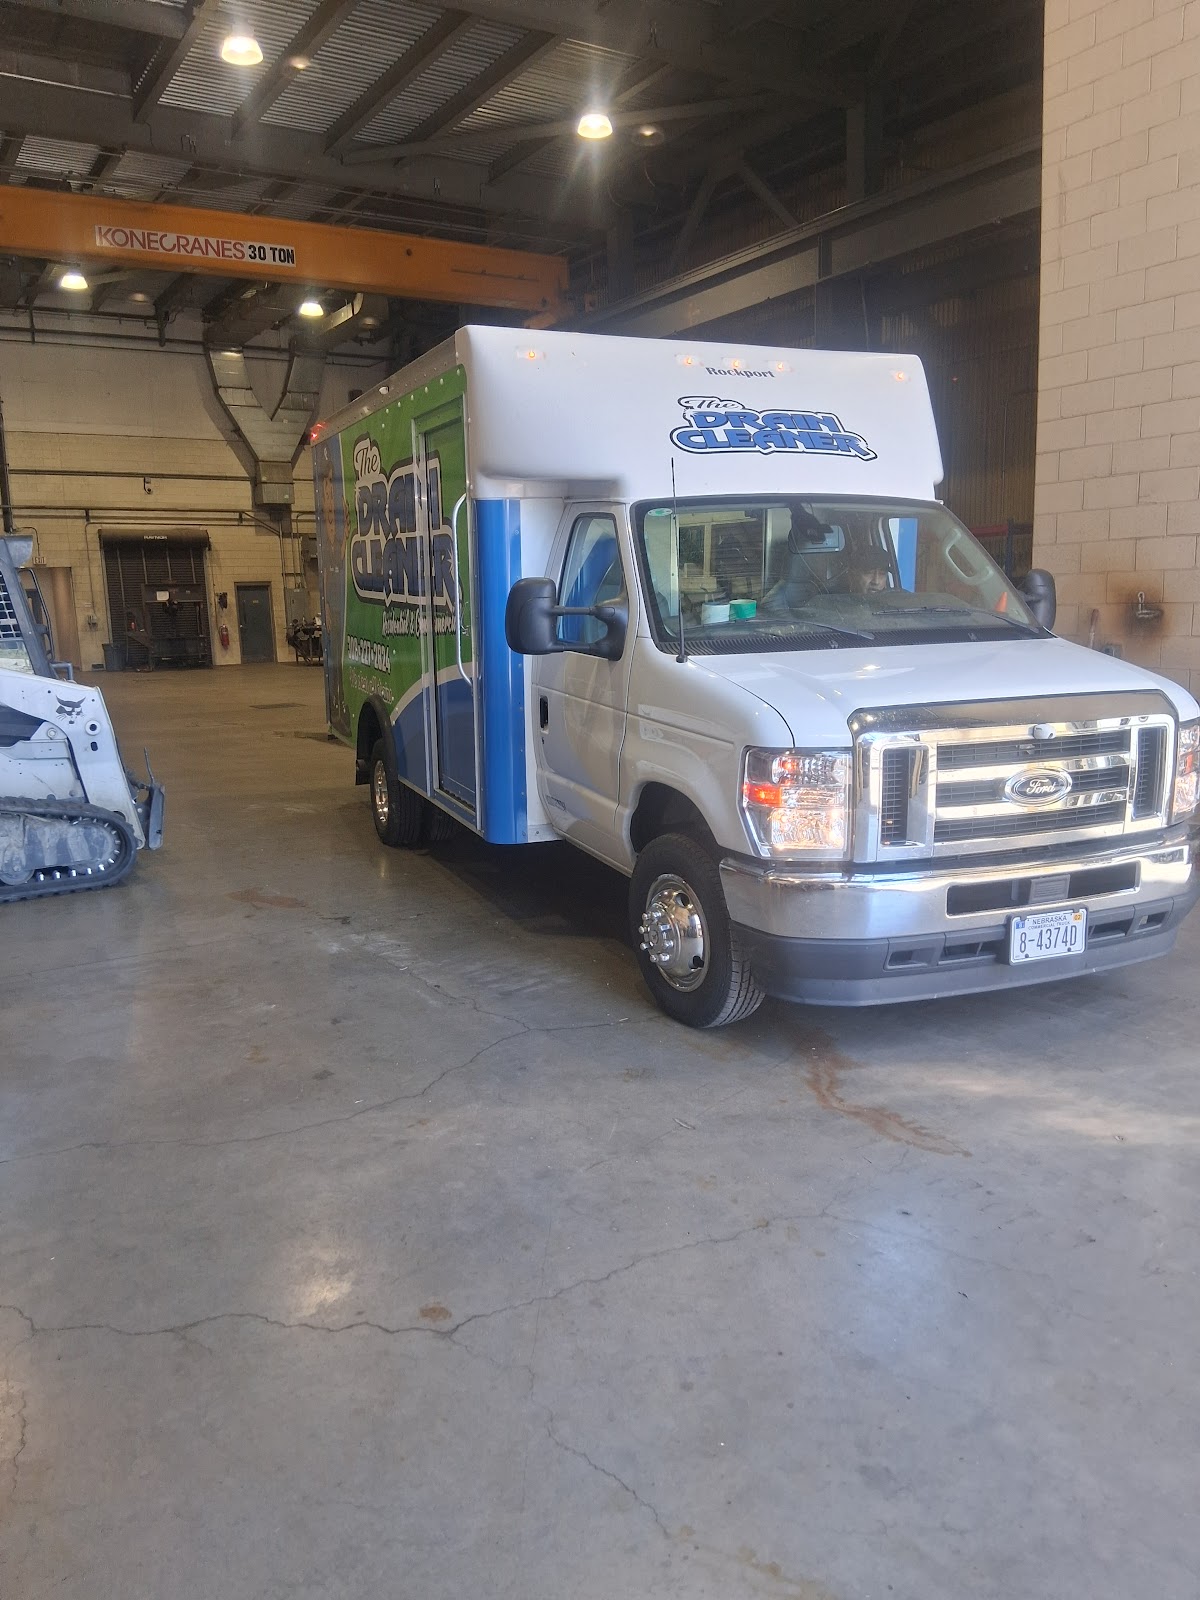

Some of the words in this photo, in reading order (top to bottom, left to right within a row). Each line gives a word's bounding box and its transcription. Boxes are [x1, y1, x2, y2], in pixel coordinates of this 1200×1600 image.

[97, 226, 246, 260] KONECRANES
[248, 245, 267, 261] 30
[269, 247, 295, 265] TON
[705, 367, 775, 379] Rockport
[684, 399, 740, 410] The
[690, 411, 843, 433] DRAIN
[676, 428, 872, 457] CLEANER
[355, 444, 380, 479] The
[1026, 778, 1056, 794] Ford
[1032, 915, 1067, 925] NEBRASKA
[1019, 925, 1078, 954] 8-4374D
